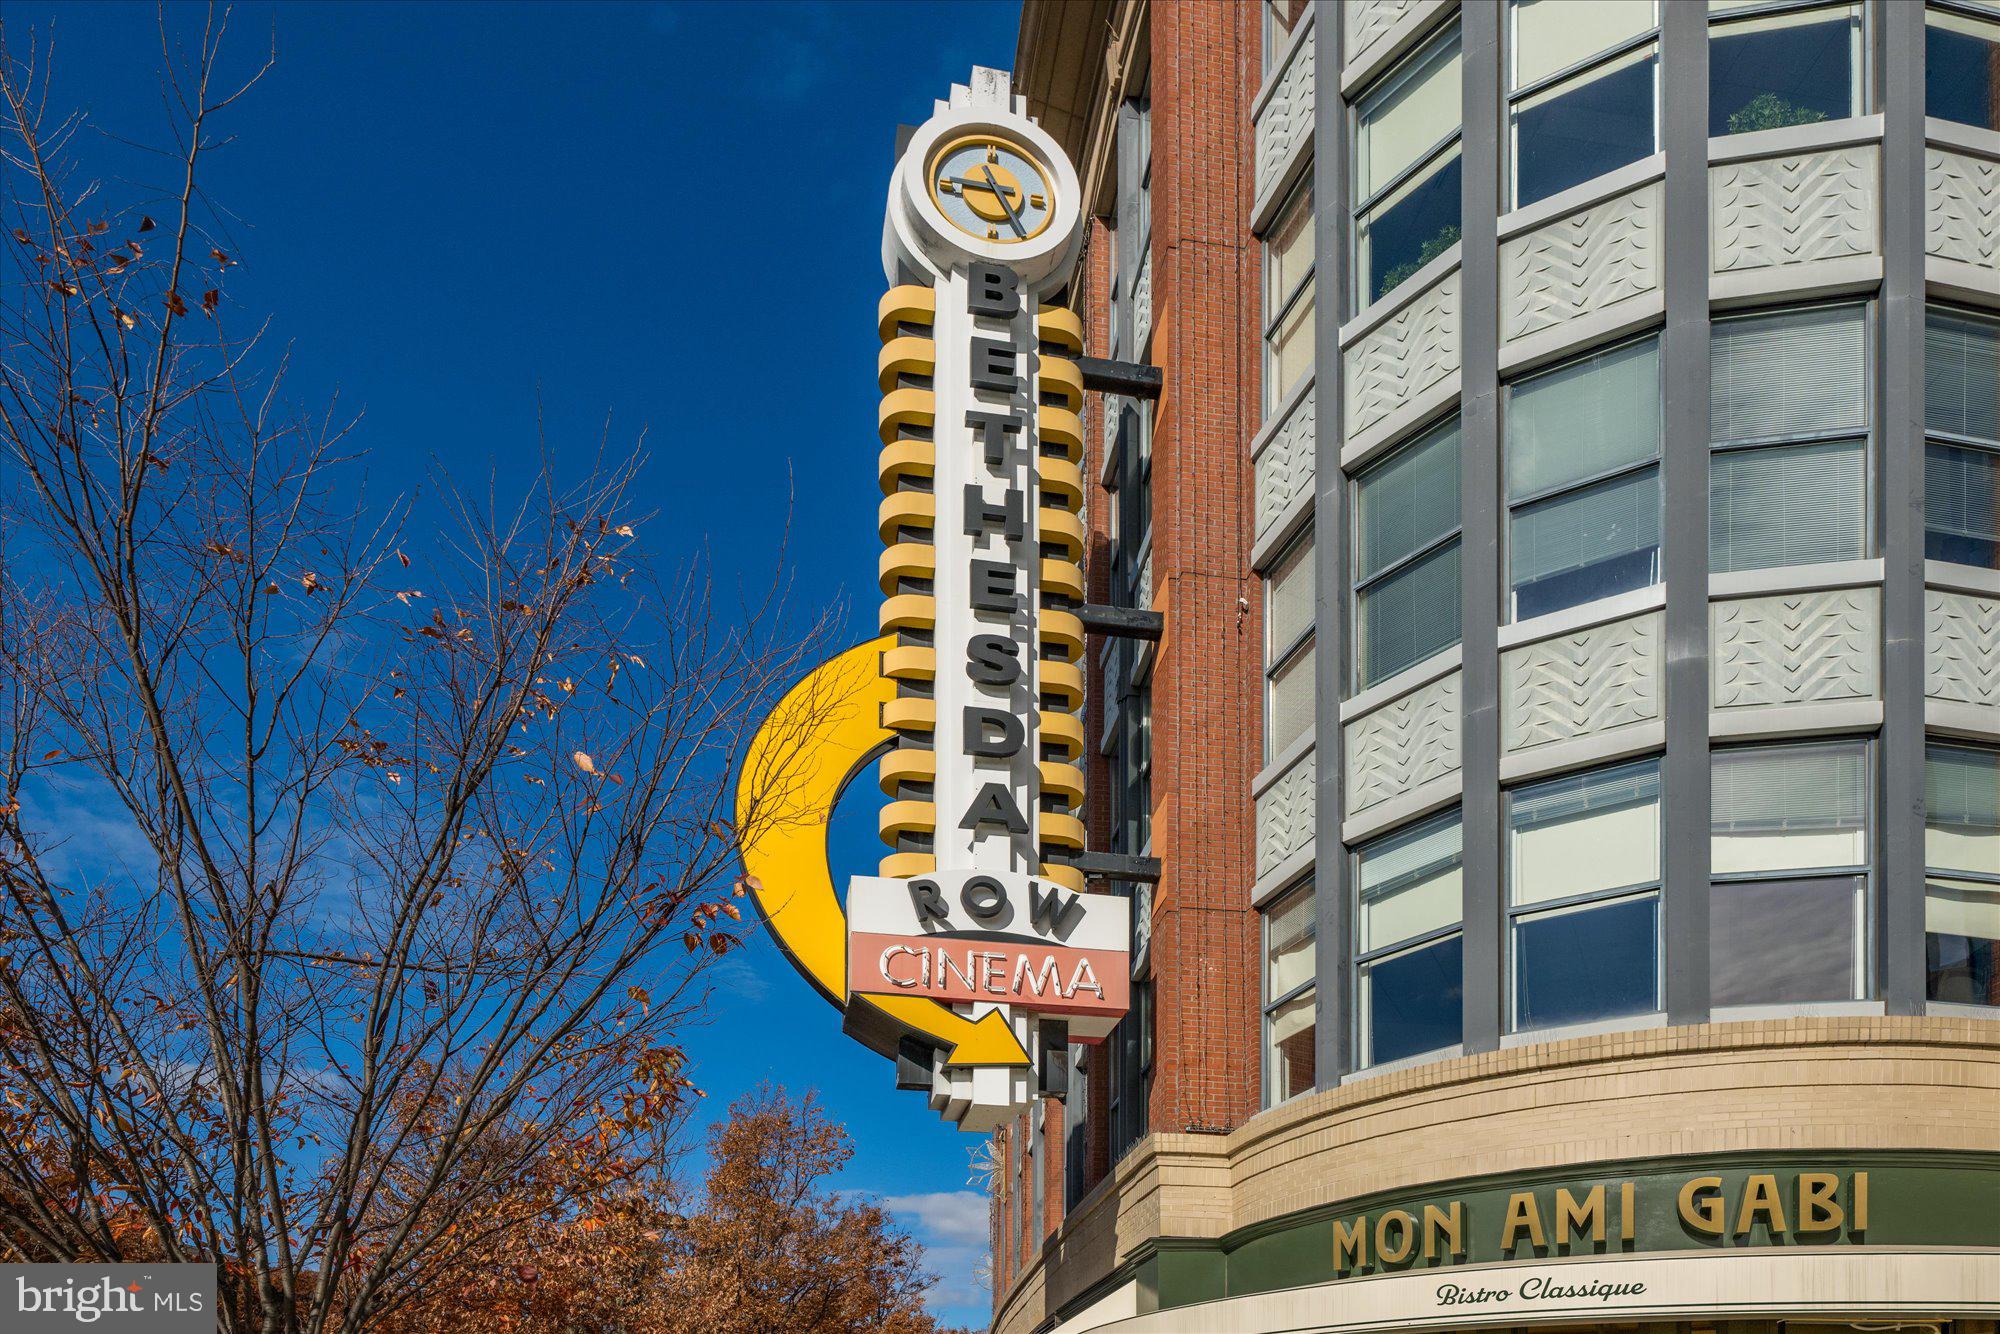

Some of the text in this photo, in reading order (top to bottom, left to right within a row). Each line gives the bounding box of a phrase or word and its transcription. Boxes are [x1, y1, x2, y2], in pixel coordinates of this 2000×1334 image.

[958, 262, 1029, 834] BETHESDA
[907, 875, 1080, 932] ROW
[879, 944, 1105, 1000] CINEMA
[1332, 1171, 1868, 1271] MON AMI GABI
[1436, 1277, 1647, 1306] Bistro Classique
